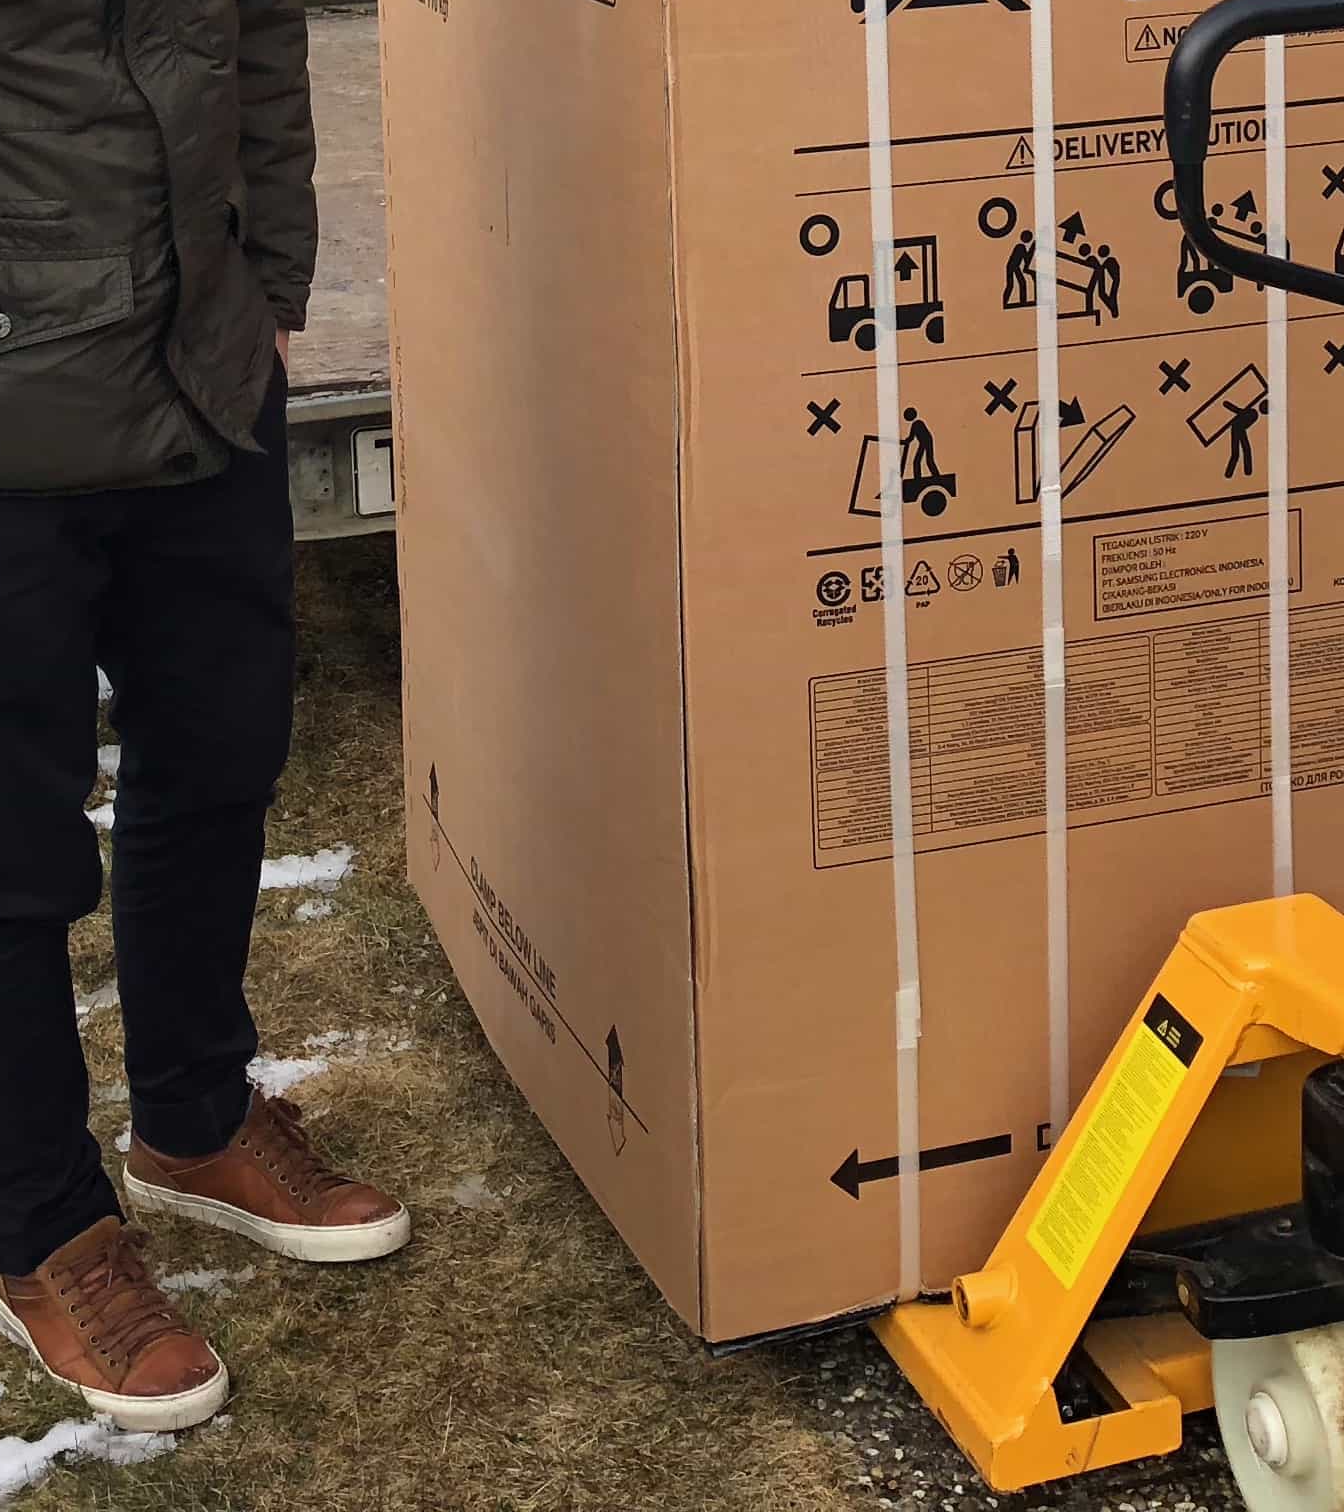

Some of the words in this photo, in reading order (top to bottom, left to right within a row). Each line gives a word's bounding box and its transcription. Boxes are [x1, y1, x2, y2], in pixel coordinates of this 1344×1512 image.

[1053, 128, 1166, 161] DELIVERY
[1116, 573, 1157, 586] SAMSUNG
[1218, 558, 1264, 571] INDONESIA
[916, 576, 928, 586] 20
[1229, 585, 1245, 594] FOR
[812, 604, 856, 618] Corrugated
[817, 615, 853, 627] Recycles
[1306, 772, 1327, 786] ДЛЯ
[471, 856, 496, 912] CLAMP
[498, 899, 531, 965] BELOW
[534, 949, 556, 1001] LINE
